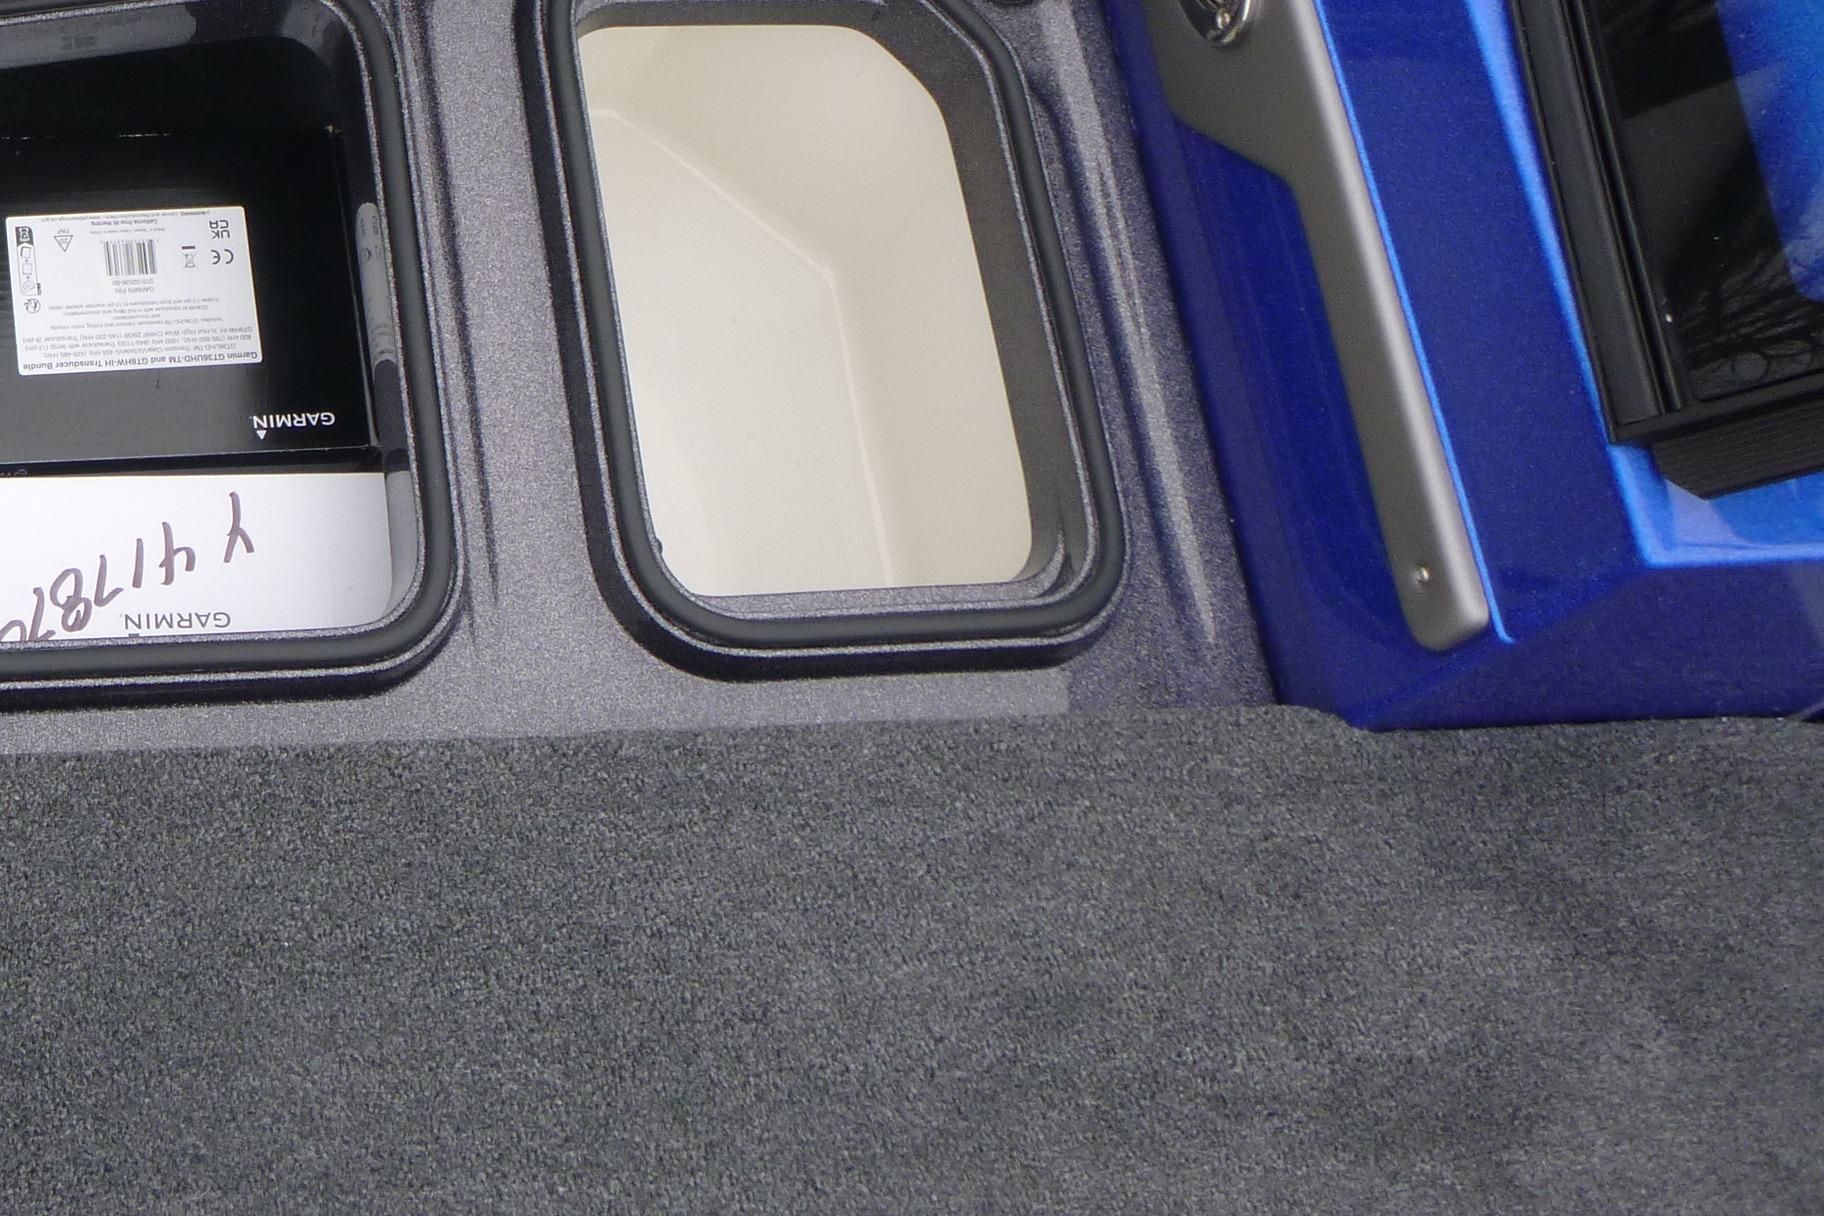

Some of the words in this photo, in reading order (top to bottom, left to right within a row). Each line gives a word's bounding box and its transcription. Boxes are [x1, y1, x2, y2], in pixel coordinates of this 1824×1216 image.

[209, 220, 229, 229] CA
[212, 230, 230, 239] UK
[151, 356, 166, 364] and
[227, 352, 257, 361] Garmin
[23, 362, 52, 370] Bundle
[56, 360, 102, 368] Transducer
[252, 412, 335, 429] GARMIN
[123, 612, 231, 630] GARMIN
